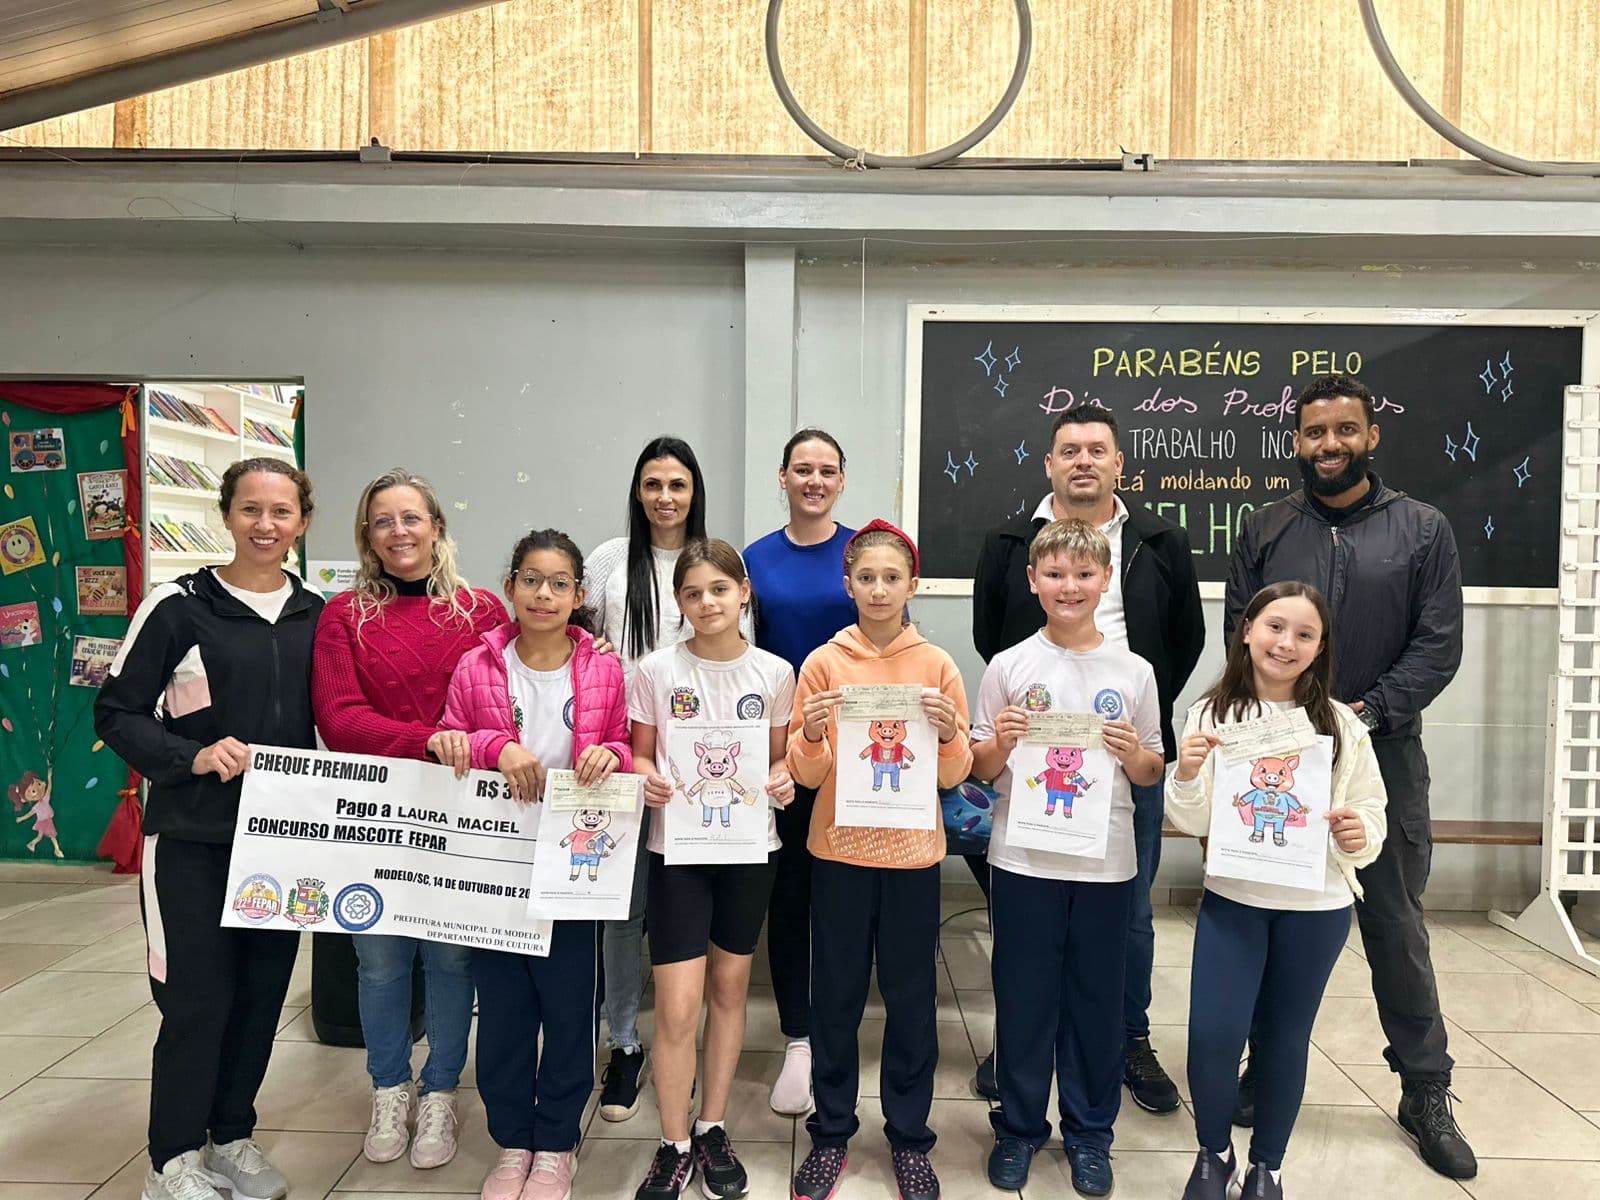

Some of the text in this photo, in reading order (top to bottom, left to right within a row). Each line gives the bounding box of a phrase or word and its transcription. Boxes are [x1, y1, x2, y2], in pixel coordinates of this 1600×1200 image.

[1093, 341, 1362, 378] PARABÉNS PELO
[1133, 387, 1198, 413] dos
[1129, 427, 1237, 460] TRABALHO
[1160, 466, 1252, 491] moldando
[1265, 476, 1290, 491] um
[253, 752, 389, 783] CHEQUE PREMIADO
[476, 779, 499, 800] R$
[336, 798, 520, 834] Pago a LAURA MACIEL
[247, 816, 447, 851] CONCURSO MASCOTE FEPAR
[865, 847, 889, 859] HAPPY
[894, 844, 920, 857] HAPPY
[374, 868, 431, 886] MODELO/SC,
[433, 876, 443, 888] 14
[445, 878, 457, 890] DE
[458, 880, 503, 897] OUTUBRO
[505, 886, 517, 899] DE
[393, 913, 442, 929] PREFEITURA
[443, 921, 488, 934] MUNICIPAL
[491, 927, 502, 936] DE
[504, 929, 540, 941] MODELO
[427, 930, 545, 953] DEPARTAMENTO DE CULTURA
